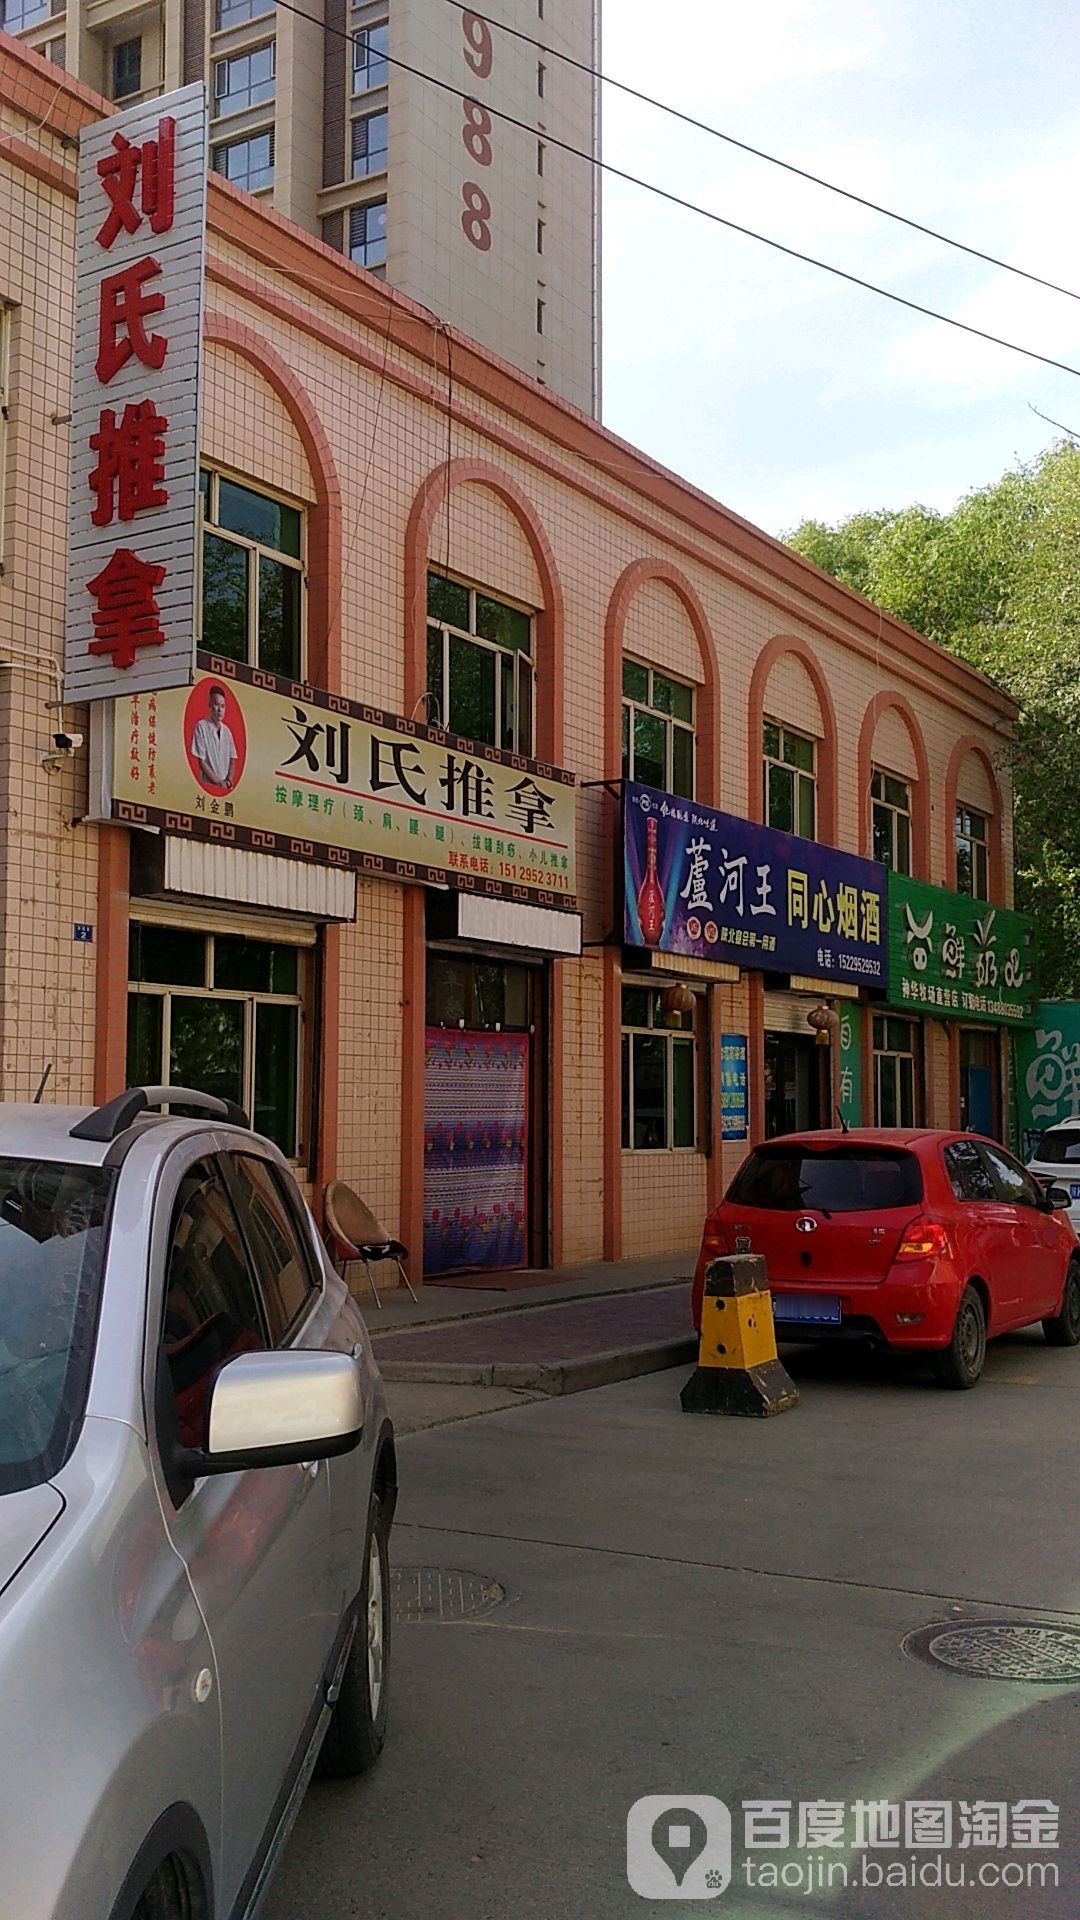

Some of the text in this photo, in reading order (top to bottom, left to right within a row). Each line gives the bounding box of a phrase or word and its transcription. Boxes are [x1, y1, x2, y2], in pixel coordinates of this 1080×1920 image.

[86, 116, 176, 670] 刘氏推拿
[147, 691, 157, 795] 病保健防衰老
[280, 705, 556, 834] 刘氏推拿
[195, 795, 234, 818] 刘金鹏
[787, 868, 880, 946] 同心烟酒
